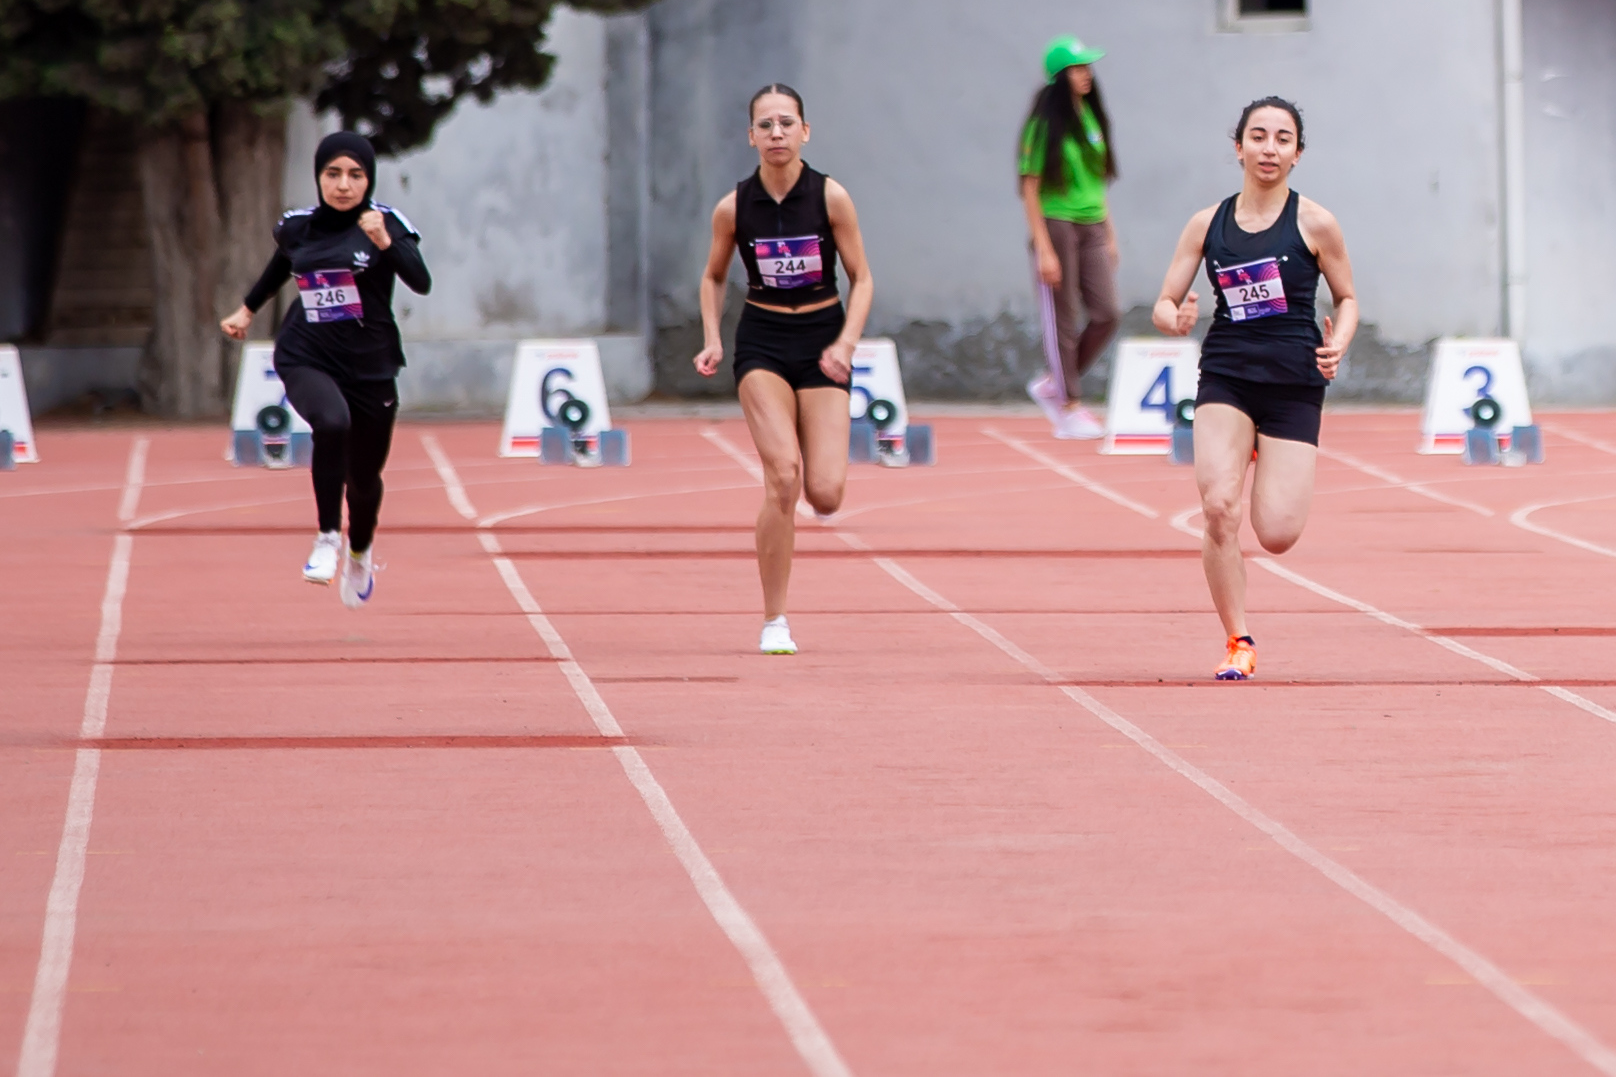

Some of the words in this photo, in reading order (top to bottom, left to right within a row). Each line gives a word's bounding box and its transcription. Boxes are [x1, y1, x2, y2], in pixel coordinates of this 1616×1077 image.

[774, 259, 806, 274] 244
[314, 289, 345, 307] 246
[1239, 284, 1270, 302] 245
[541, 367, 577, 425] 6
[1140, 365, 1177, 425] 4
[1462, 365, 1497, 424] 3
